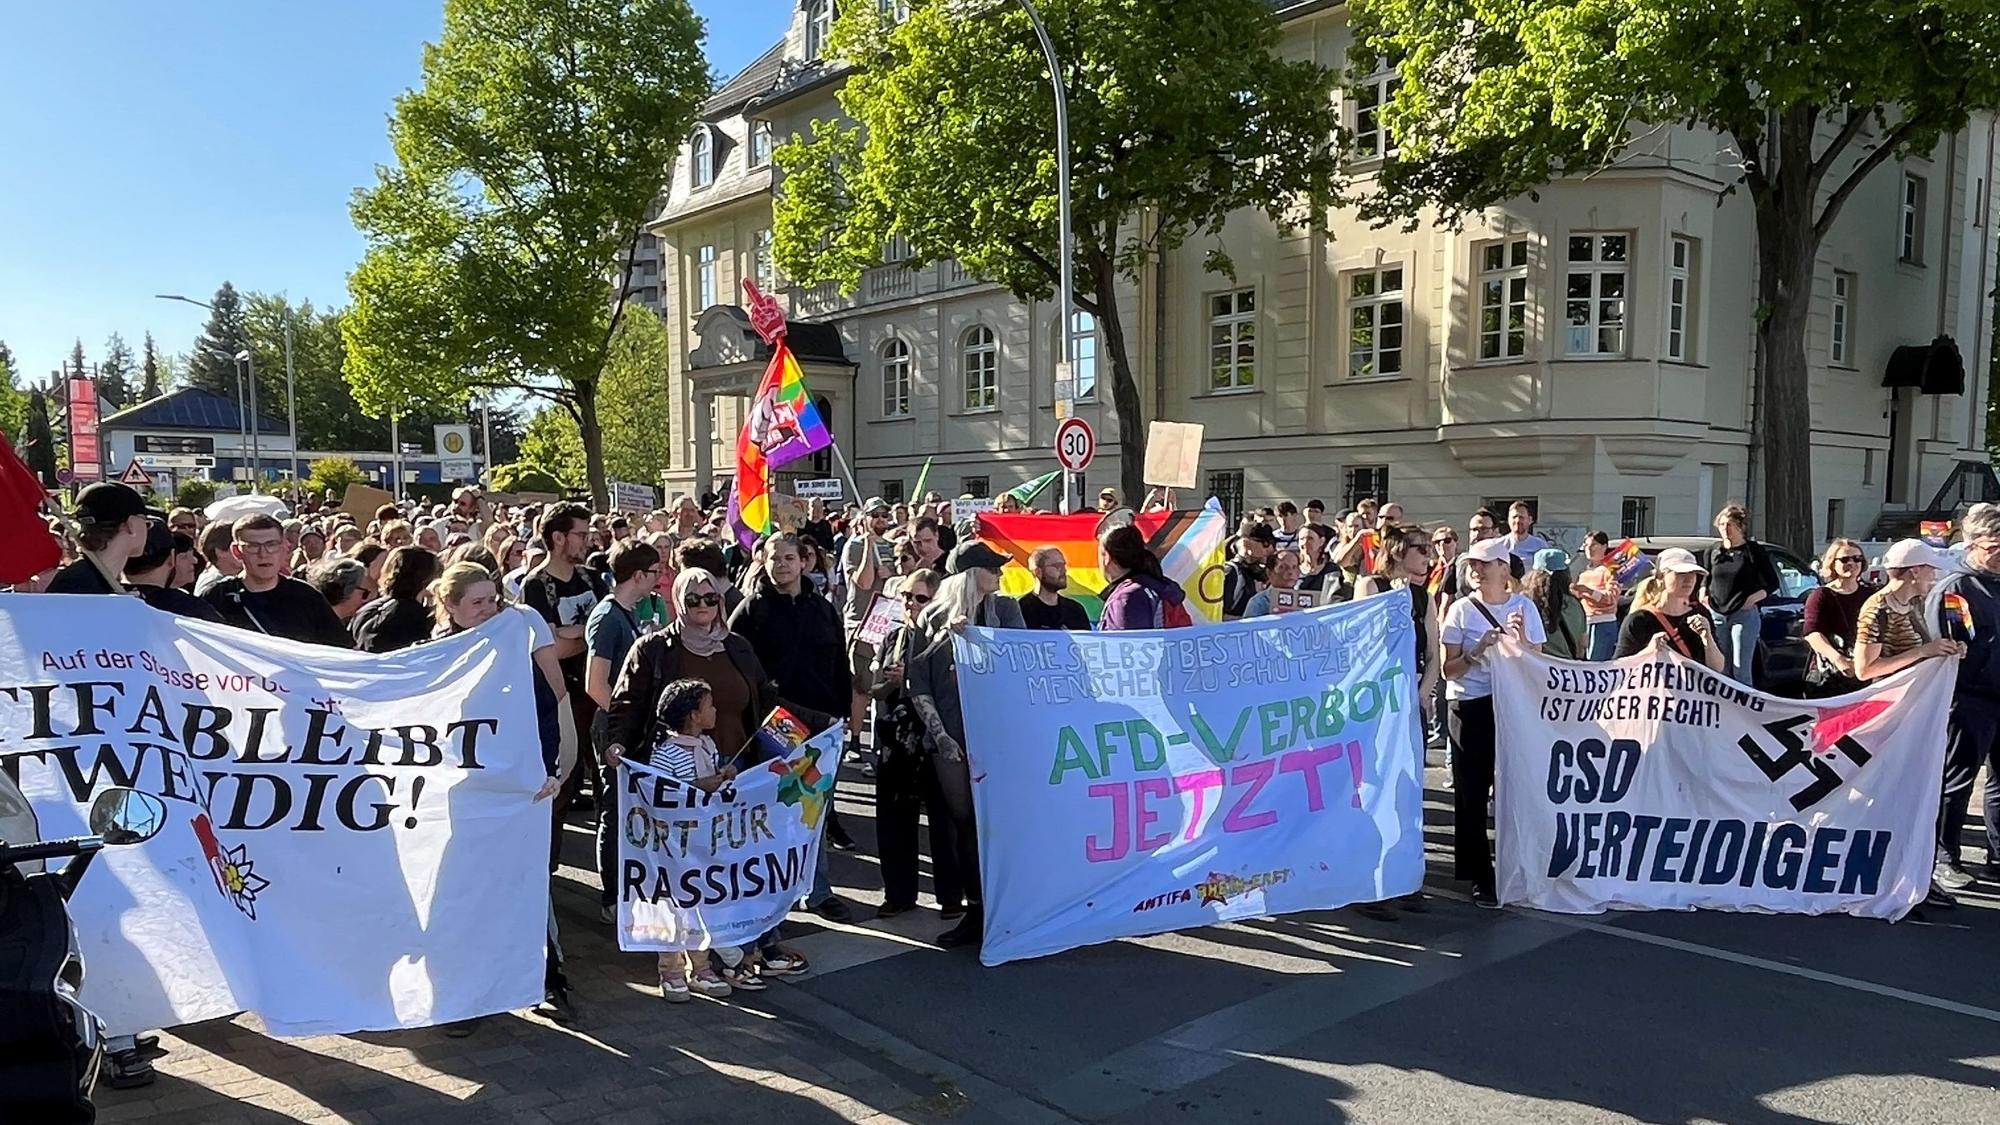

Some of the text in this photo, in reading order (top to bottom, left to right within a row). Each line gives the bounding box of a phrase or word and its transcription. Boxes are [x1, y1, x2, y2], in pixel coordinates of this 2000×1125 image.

[1064, 433, 1087, 457] 30
[43, 650, 86, 671] Auf
[95, 649, 134, 669] der
[215, 674, 256, 692] vor
[969, 641, 1018, 675] UM
[1020, 639, 1062, 673] DIE
[1028, 669, 1173, 706] MENSCHEN
[1183, 668, 1222, 694] ZU
[1049, 664, 1404, 785] AFD-VERBOT
[1540, 695, 1721, 728] IST UNSER RECHT!
[1546, 738, 1642, 805] CSD
[1085, 740, 1364, 864] JETZT!
[625, 802, 775, 858] ORT FÜR
[1546, 811, 1893, 896] VERTEIDIGEN
[1133, 888, 1192, 913] ANTIFA
